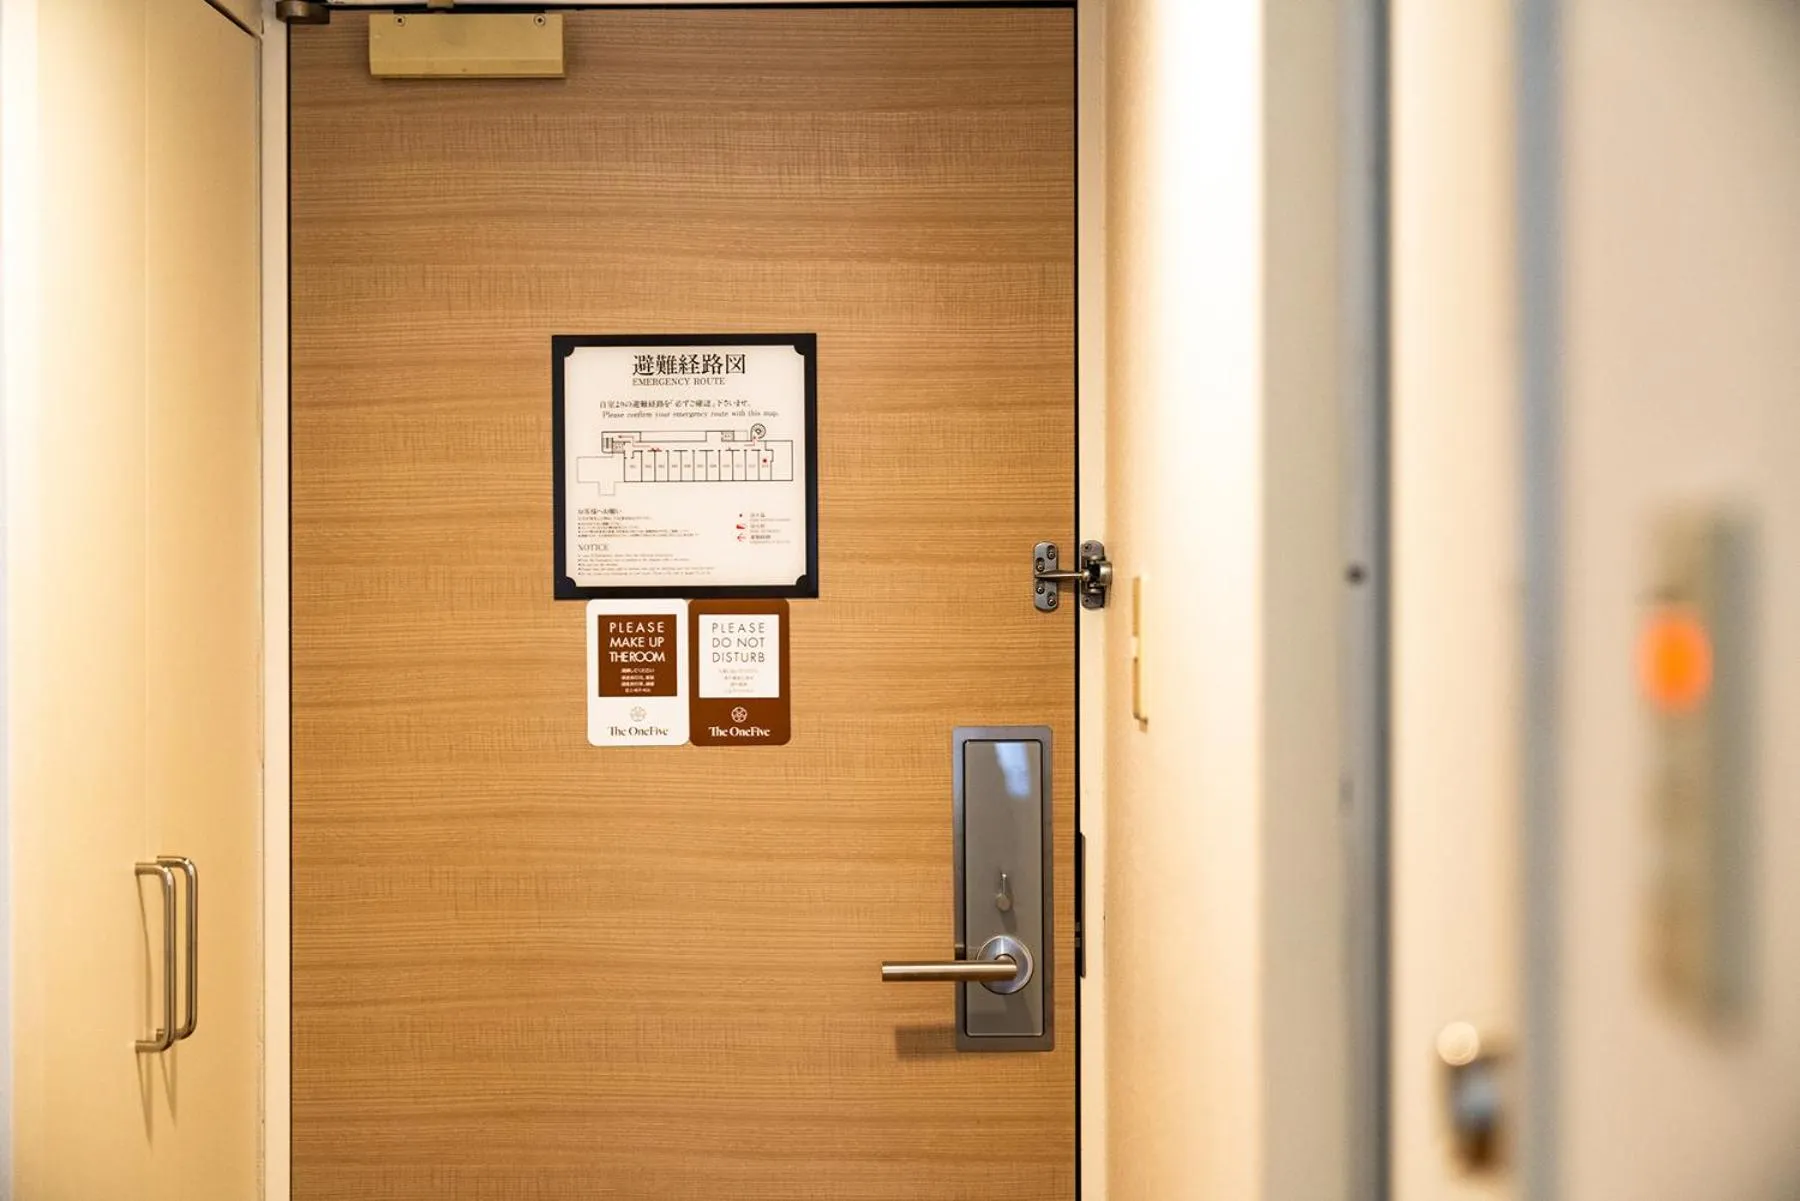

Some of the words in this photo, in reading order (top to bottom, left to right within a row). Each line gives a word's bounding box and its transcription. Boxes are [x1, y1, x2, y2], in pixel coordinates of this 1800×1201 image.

[632, 354, 746, 376] 避難経路図
[632, 377, 691, 386] EMERGENCY
[693, 377, 726, 386] ROUTE
[603, 410, 625, 418] Please
[578, 543, 609, 551] NOTICE
[609, 621, 665, 633] PLEASE
[711, 622, 765, 634] PLEASE
[609, 636, 645, 648] MAKE
[648, 636, 665, 648] UP
[711, 637, 732, 649] DO
[736, 637, 765, 649] NOT
[711, 651, 765, 663] DISTURB
[608, 726, 627, 737] The
[628, 726, 669, 737] OneFive
[709, 726, 727, 737] The
[729, 726, 771, 737] OneFive
